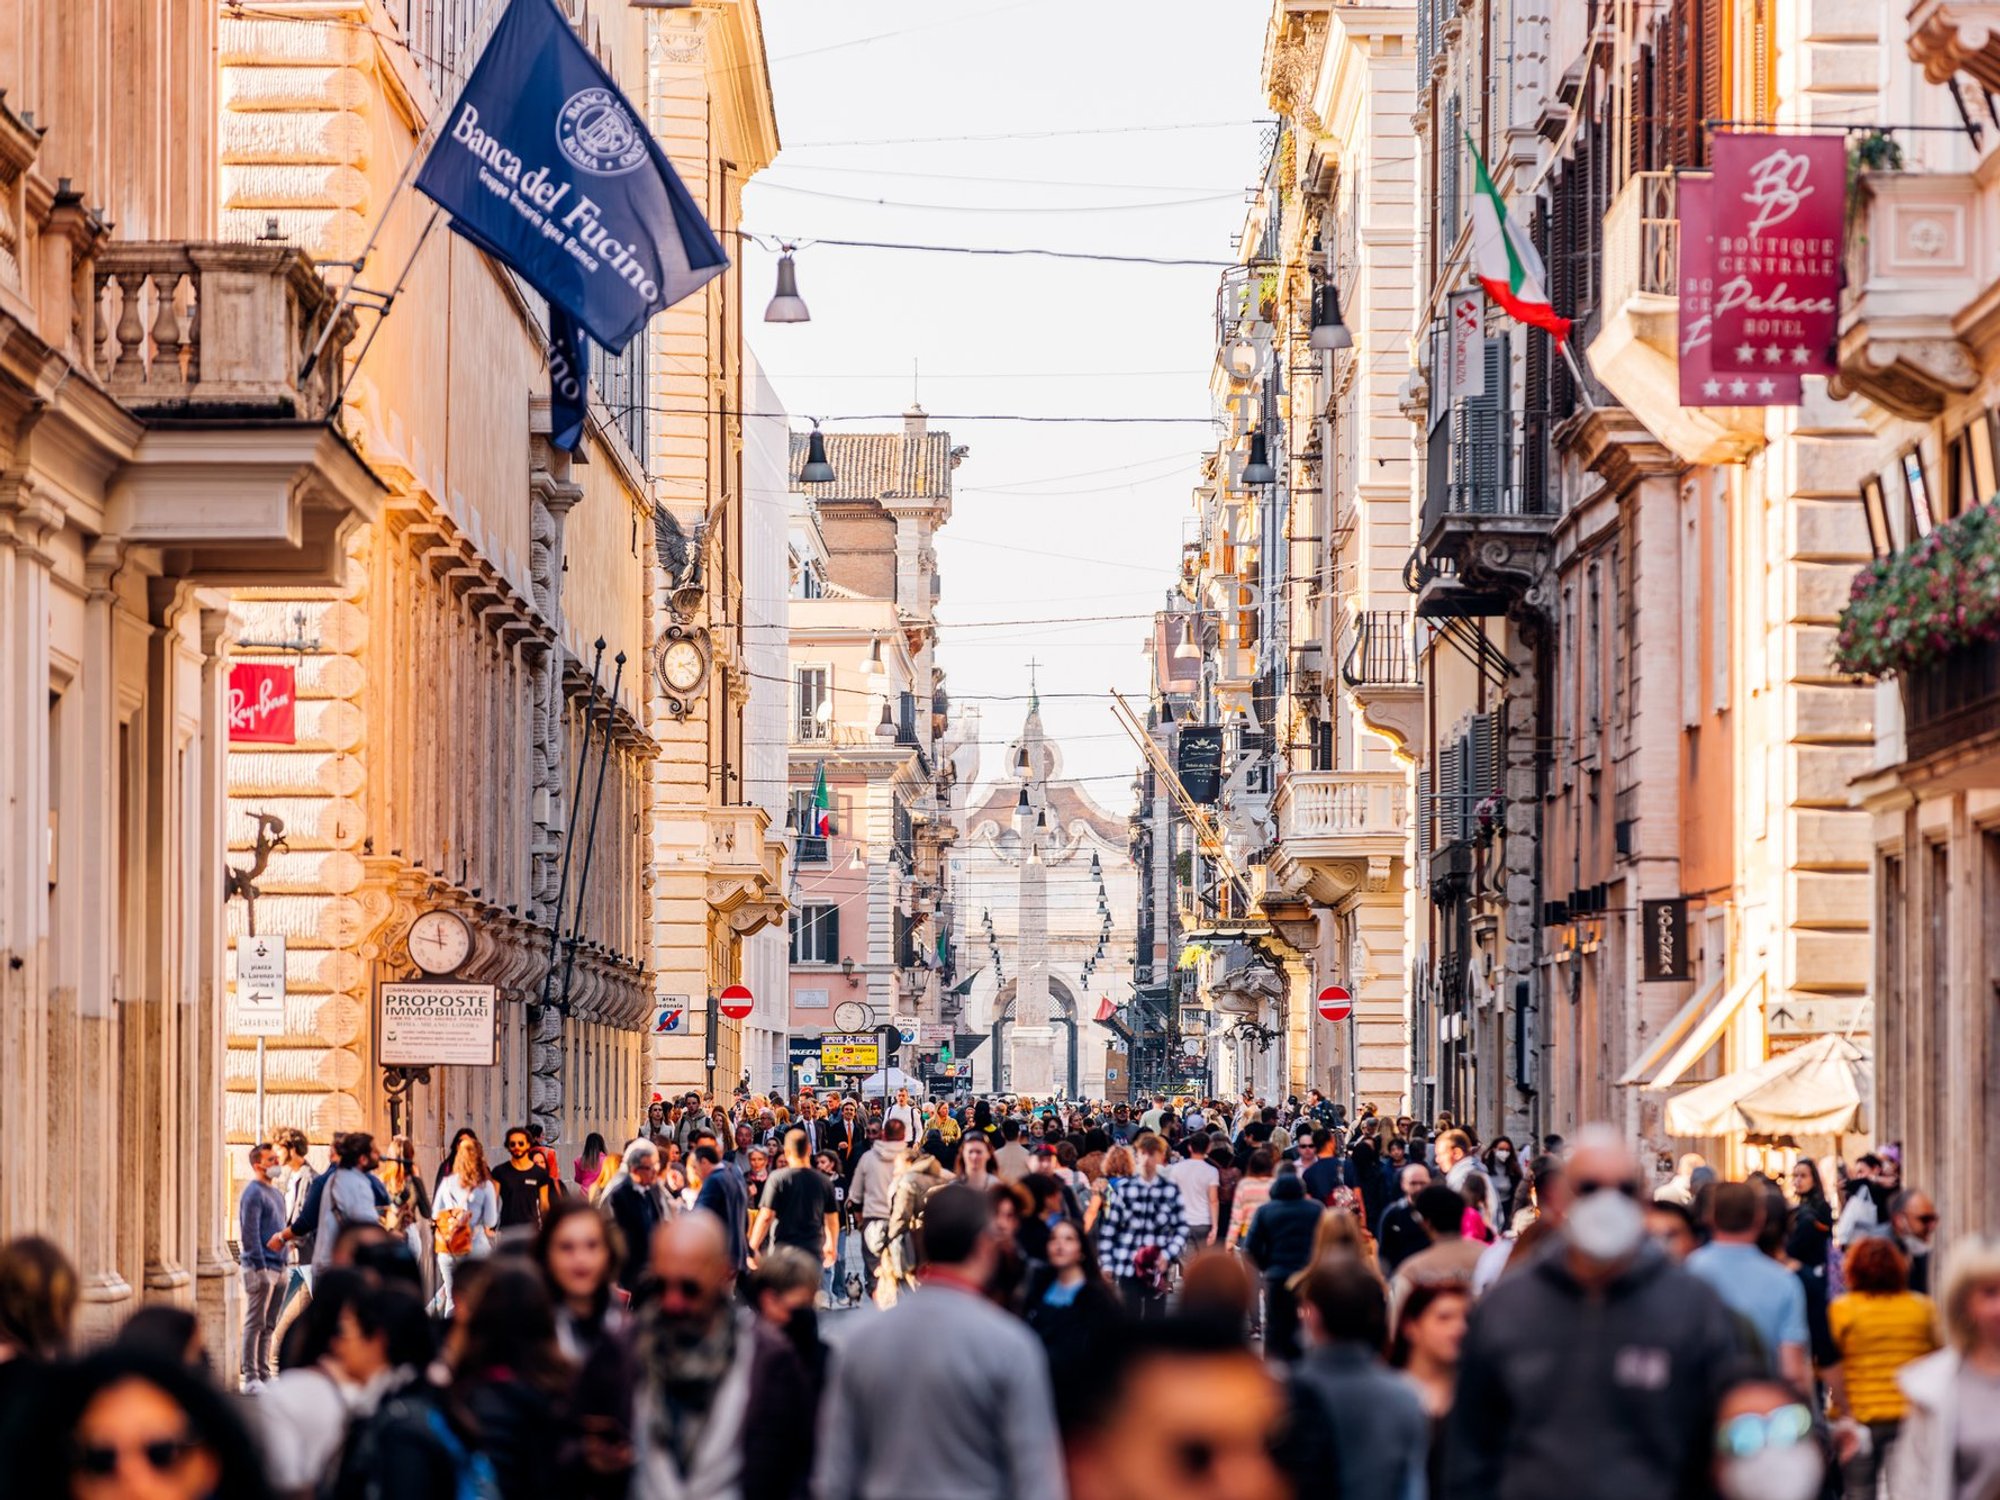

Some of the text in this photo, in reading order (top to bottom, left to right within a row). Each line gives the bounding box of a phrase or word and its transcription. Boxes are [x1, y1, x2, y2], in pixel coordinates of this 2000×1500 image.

[566, 93, 612, 121] BANCA
[563, 136, 599, 170] ROMA
[452, 102, 522, 183] Banca
[520, 166, 571, 211] del
[562, 194, 658, 303] Fucino
[479, 166, 600, 273] Gruppo Bancario Igea Banca
[1718, 236, 1834, 257] BOUTIQUE
[1718, 256, 1834, 275] CENTRALE
[1714, 275, 1836, 319] Palace
[1743, 318, 1806, 336] HOTEL
[1224, 279, 1265, 545] HOTEL
[1657, 905, 1674, 975] COLONNA
[385, 994, 488, 1008] PROPOSTE
[385, 1006, 488, 1017] IMMOBILIARI
[834, 1186, 844, 1201] B
